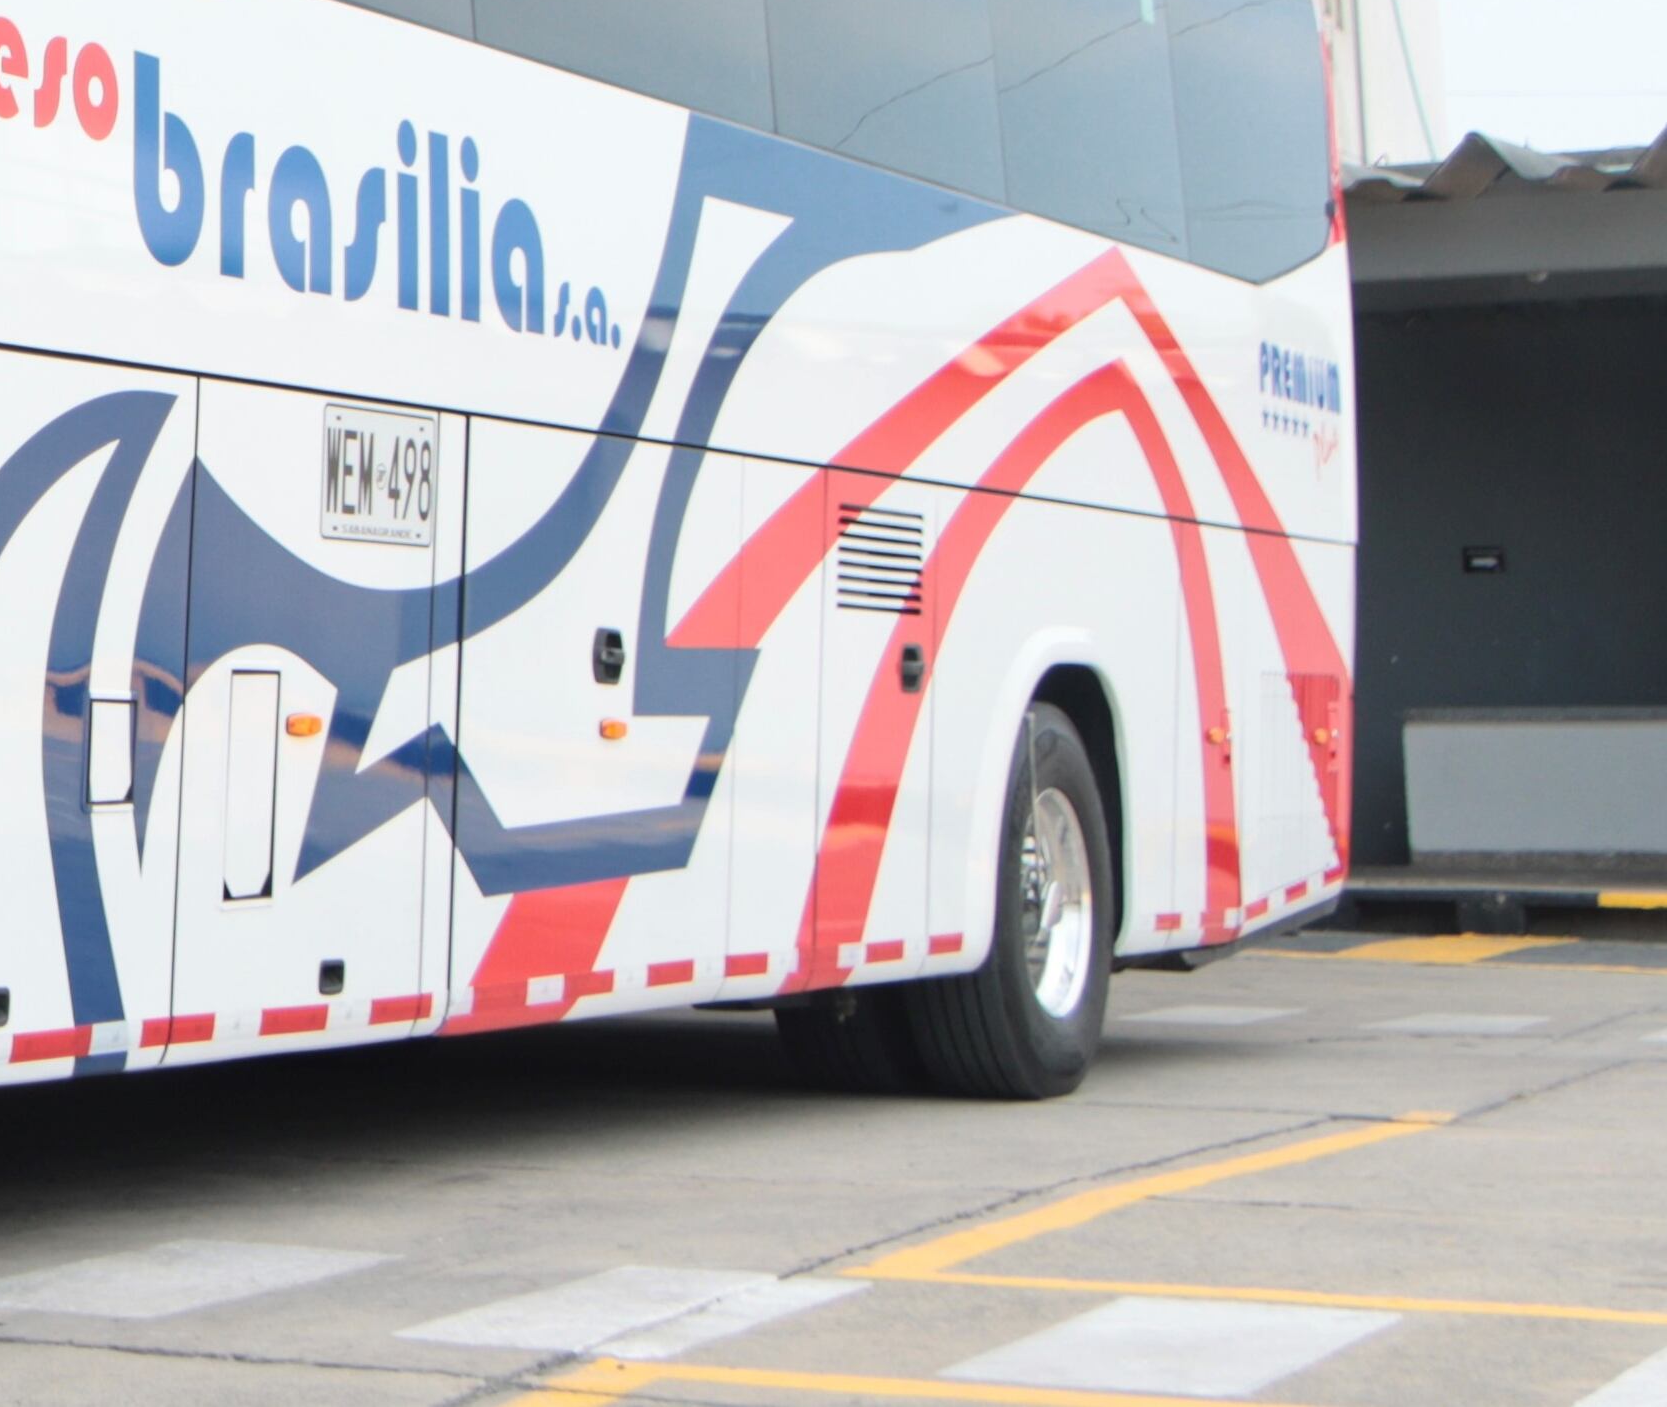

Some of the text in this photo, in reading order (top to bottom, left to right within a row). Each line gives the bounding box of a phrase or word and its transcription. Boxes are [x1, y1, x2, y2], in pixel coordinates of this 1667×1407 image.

[133, 50, 545, 335] brasilia
[1259, 341, 1342, 416] PREMIUM
[326, 427, 432, 522] WEM 498
